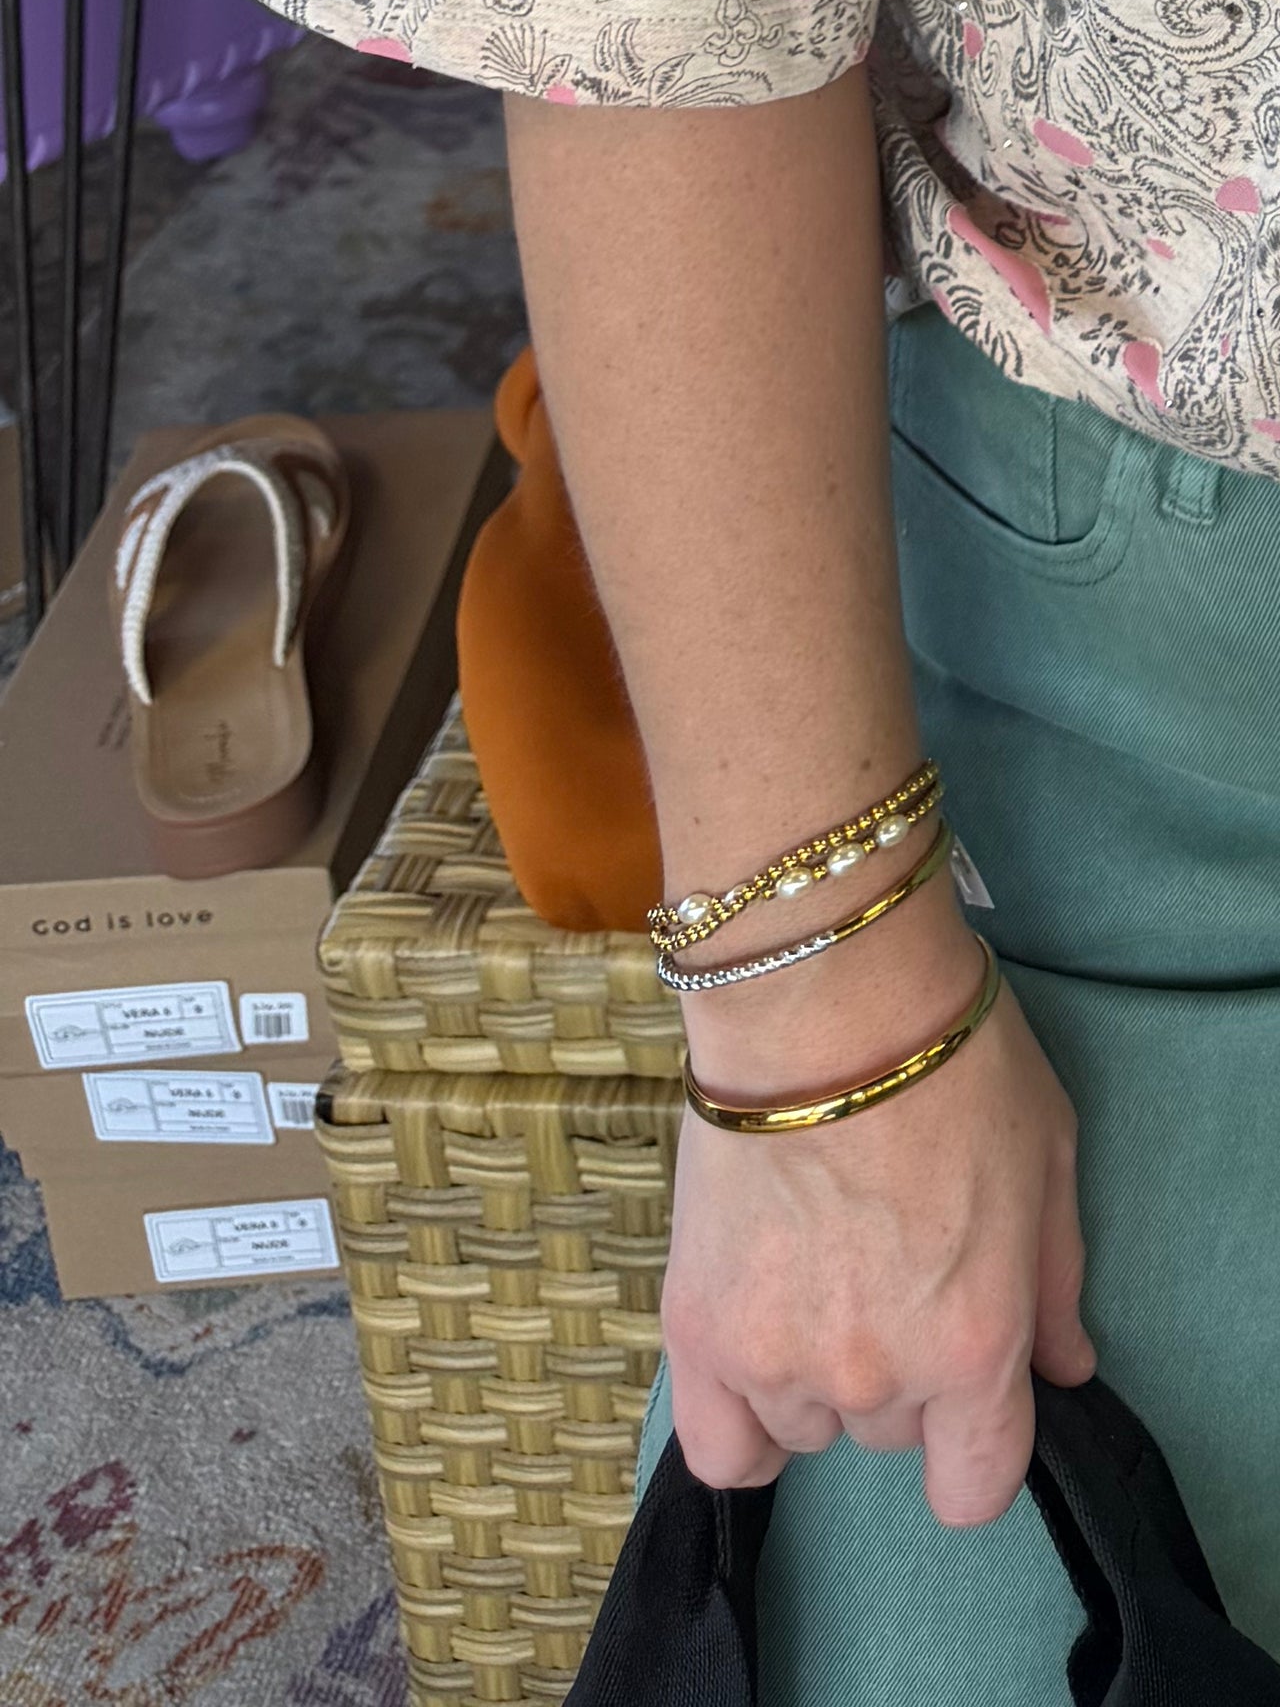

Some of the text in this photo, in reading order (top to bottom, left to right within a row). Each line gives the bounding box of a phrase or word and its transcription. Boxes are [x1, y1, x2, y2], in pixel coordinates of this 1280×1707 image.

[31, 907, 215, 937] God is love
